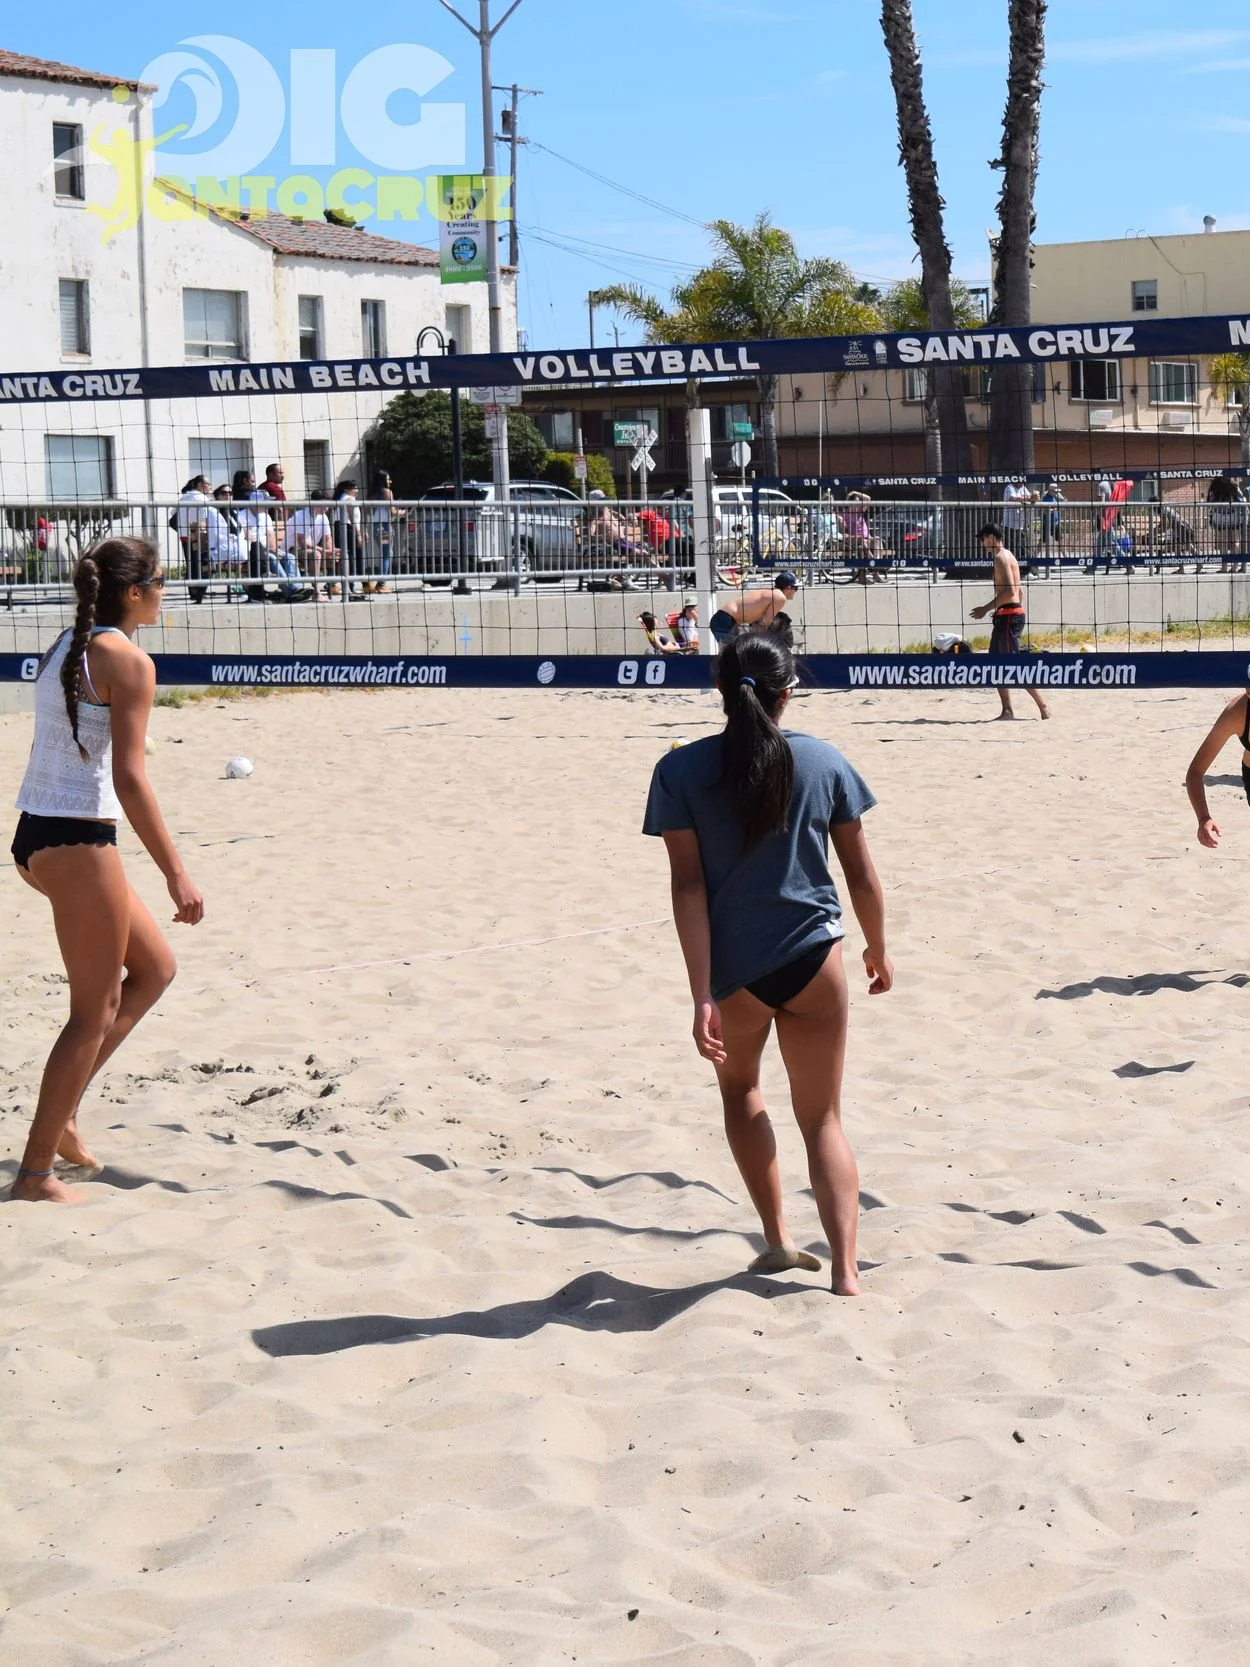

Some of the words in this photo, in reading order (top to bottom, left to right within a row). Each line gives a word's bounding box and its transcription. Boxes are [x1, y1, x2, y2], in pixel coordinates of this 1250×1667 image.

[448, 197, 477, 210] 150
[448, 211, 476, 221] Years
[0, 377, 58, 398] NTA
[62, 373, 143, 398] CRUZ
[209, 367, 296, 391] MAIN
[309, 361, 431, 388] BEACH
[513, 347, 760, 380] VOLLEYBALL
[897, 333, 1021, 363] SANTA
[1028, 327, 1135, 357] CRUZ
[910, 477, 937, 485] CRUZ
[958, 476, 985, 484] MAIN
[989, 475, 1027, 483] BEACH
[1051, 473, 1122, 482] VOLLEYBALL
[1159, 470, 1192, 479] SANTA
[1195, 469, 1223, 478] CRUZ
[212, 661, 447, 684] www.santacruzwharf.com
[849, 659, 1136, 685] www.santacruzwharf.com
